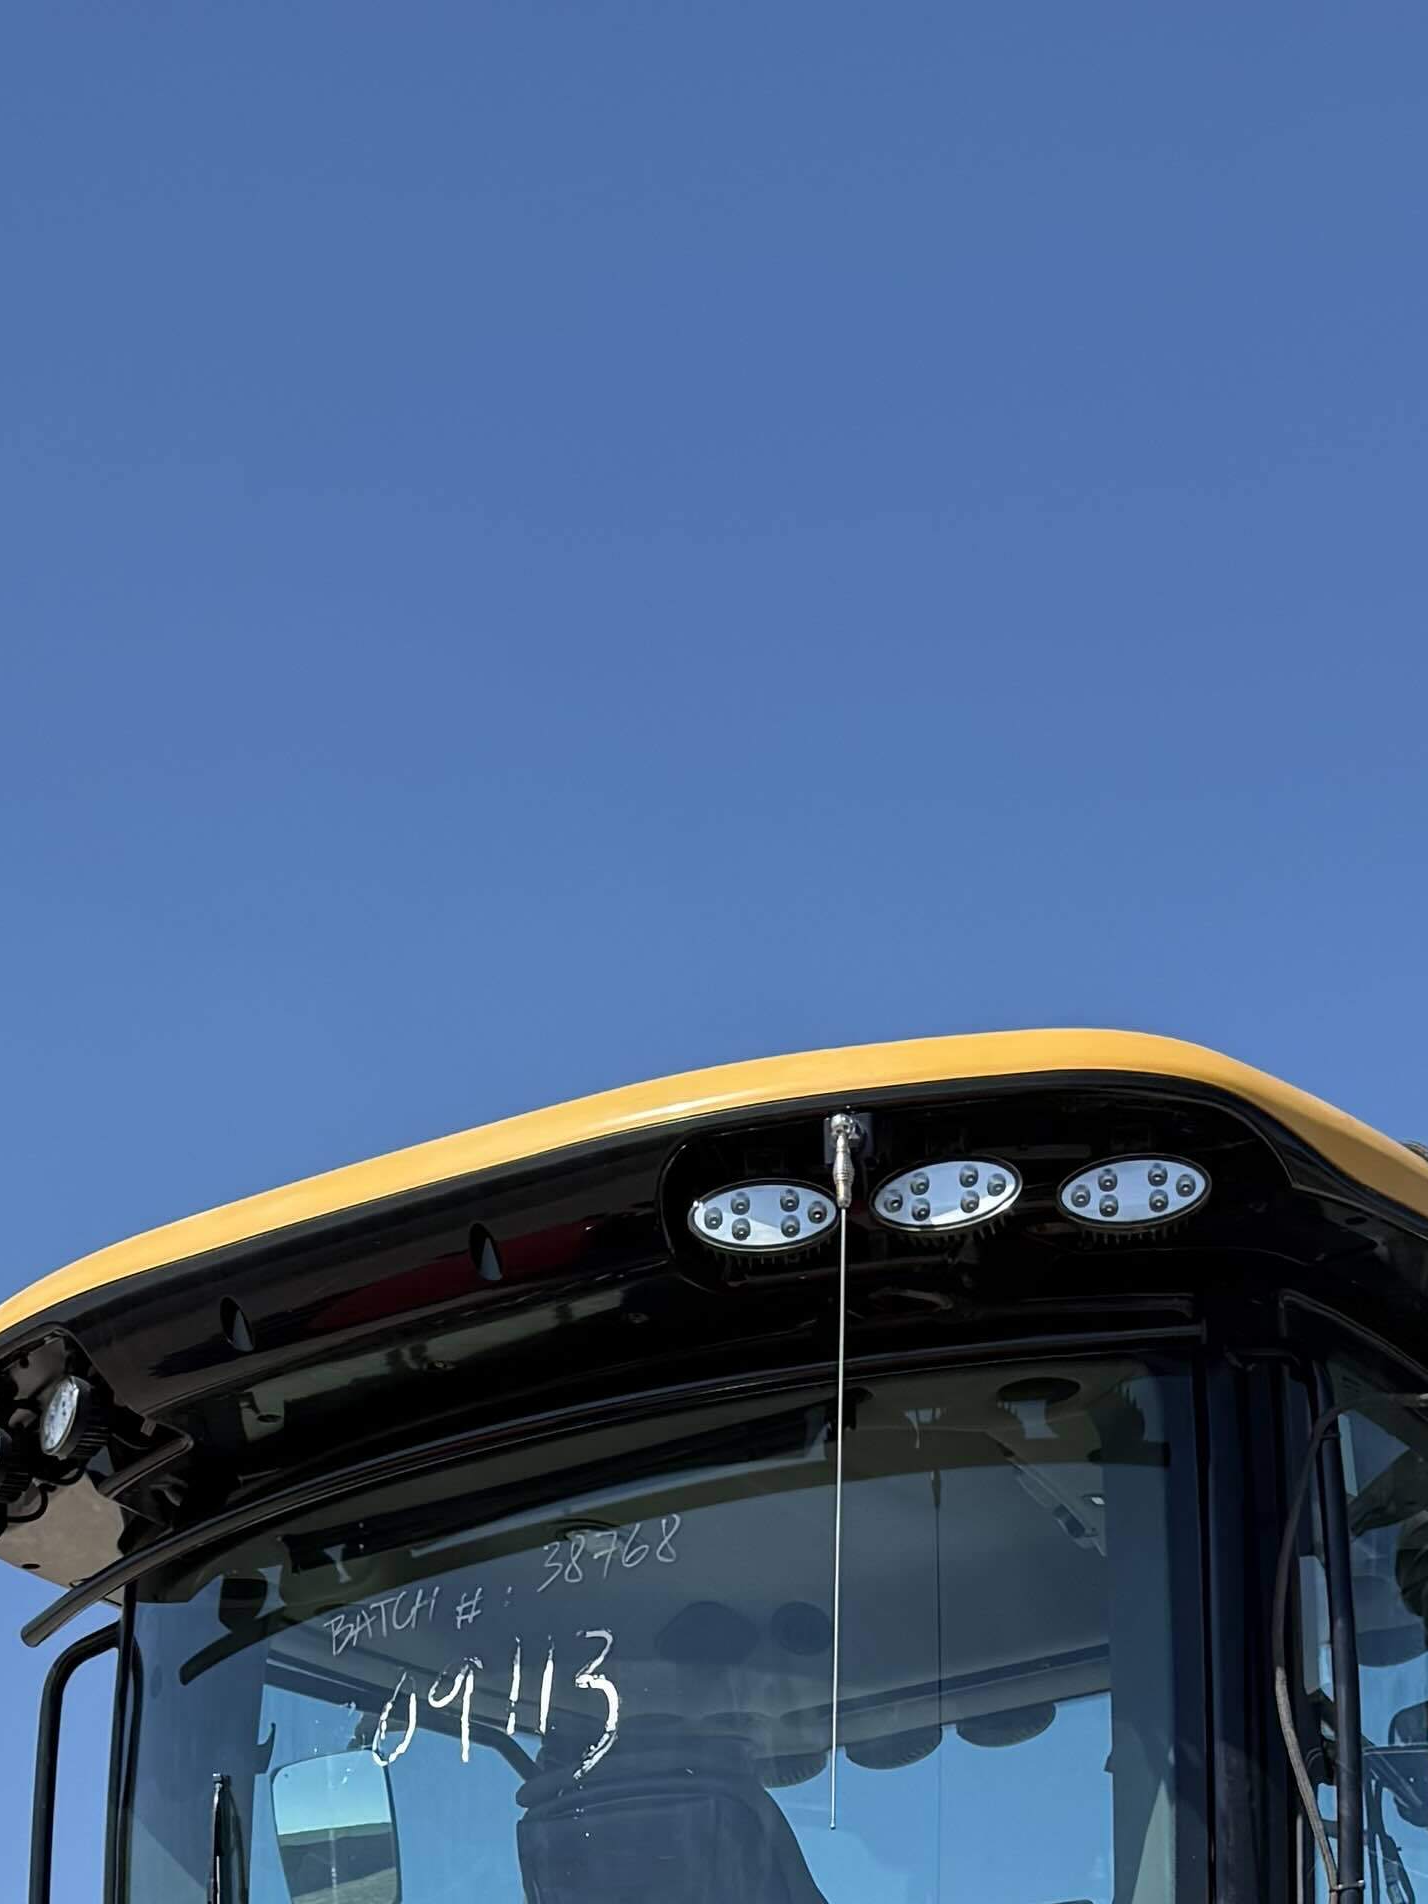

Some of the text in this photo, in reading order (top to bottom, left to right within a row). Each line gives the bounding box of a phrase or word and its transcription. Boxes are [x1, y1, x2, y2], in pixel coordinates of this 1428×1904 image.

[323, 1586, 440, 1656] BATCH
[537, 1513, 682, 1592] 38768
[371, 1628, 622, 1780] 09113
